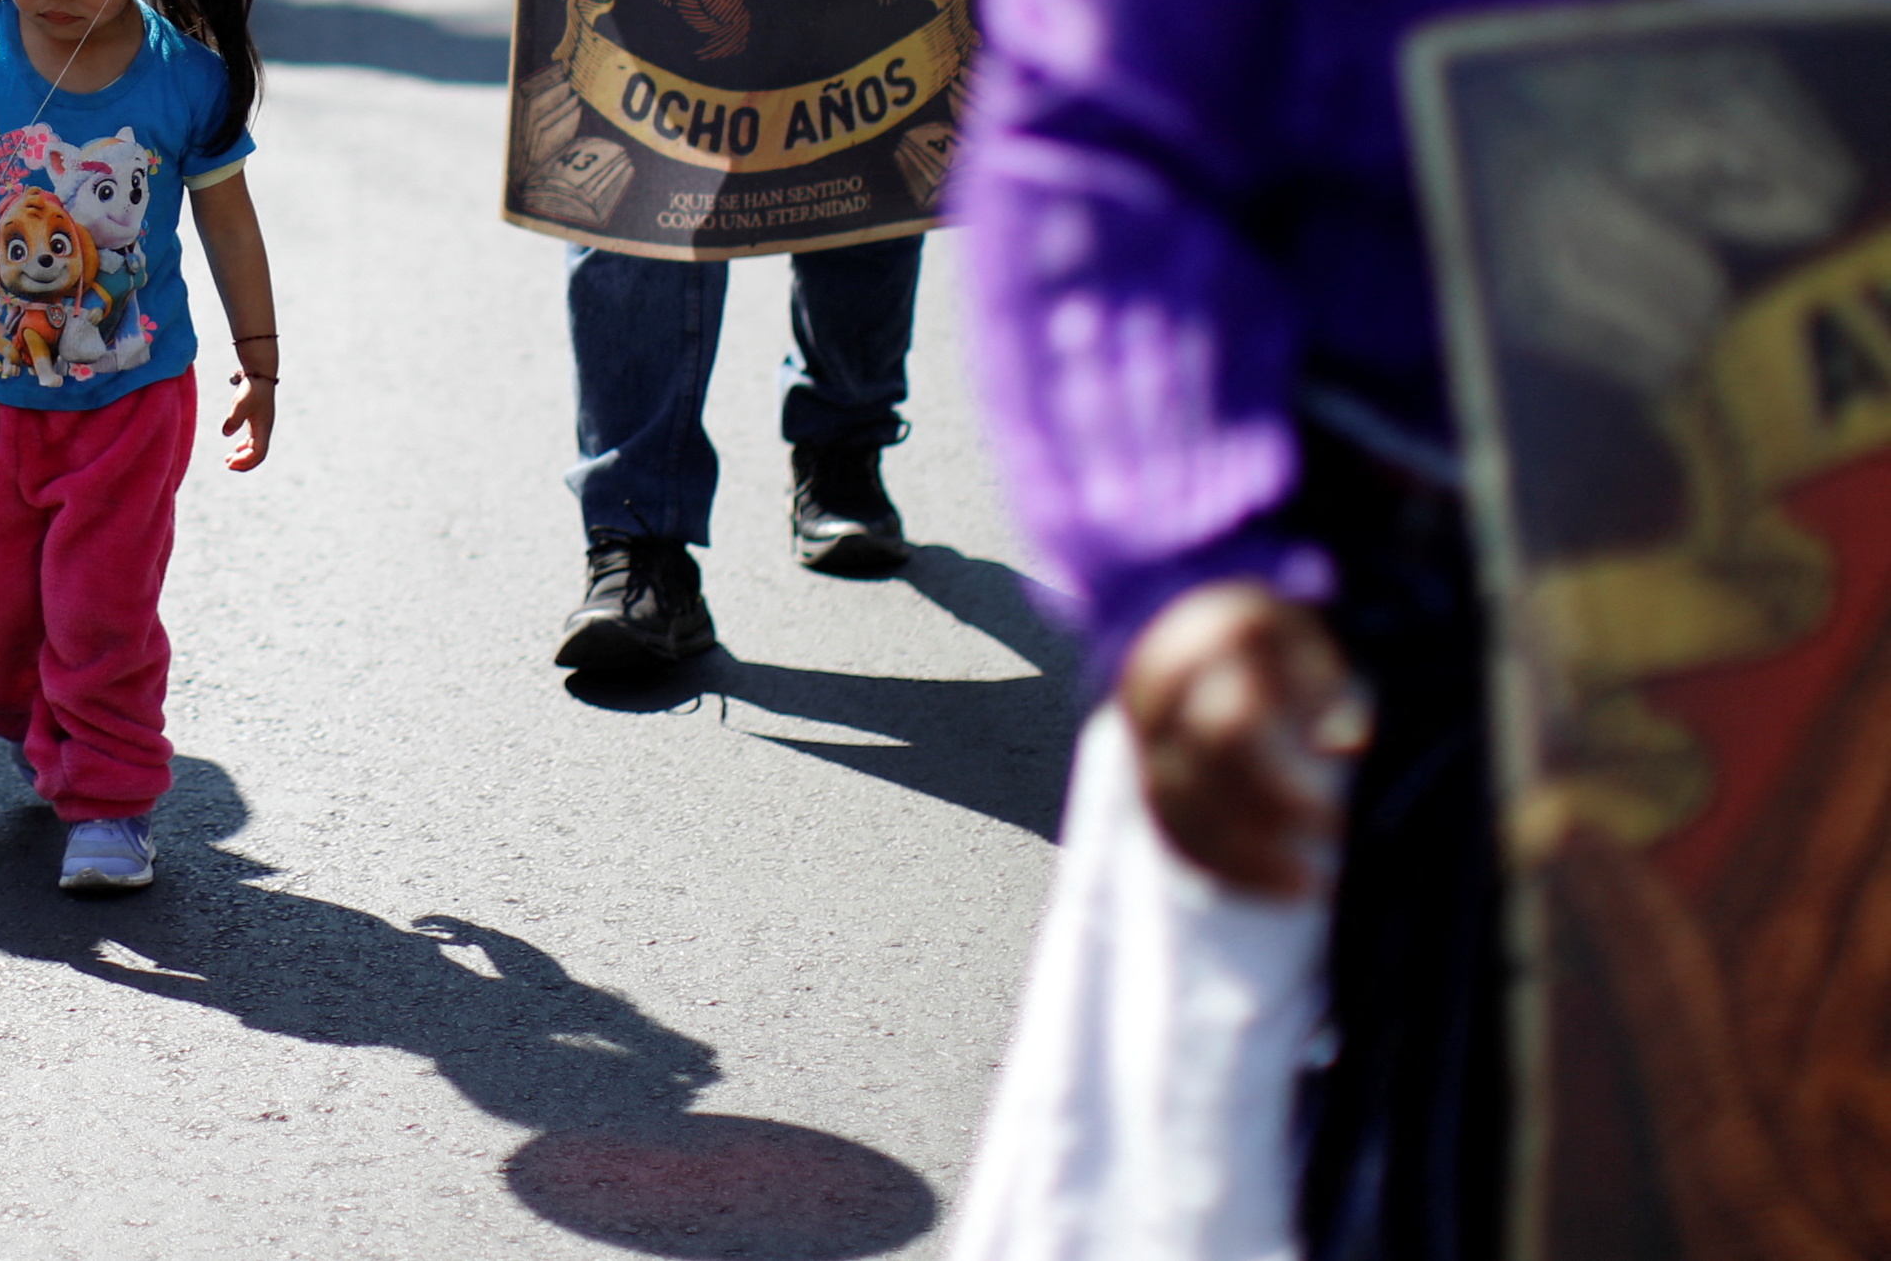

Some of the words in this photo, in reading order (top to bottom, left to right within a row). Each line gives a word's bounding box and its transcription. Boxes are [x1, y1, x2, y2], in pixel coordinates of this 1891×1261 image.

[621, 71, 760, 157] OCHO
[783, 57, 917, 150] AÑOS
[657, 211, 716, 230] COMO
[719, 212, 763, 229] UNA
[765, 192, 872, 226] ETERNIDAD!
[718, 194, 740, 210] SE
[744, 189, 784, 207] HAN
[787, 175, 864, 202] SENTIDO
